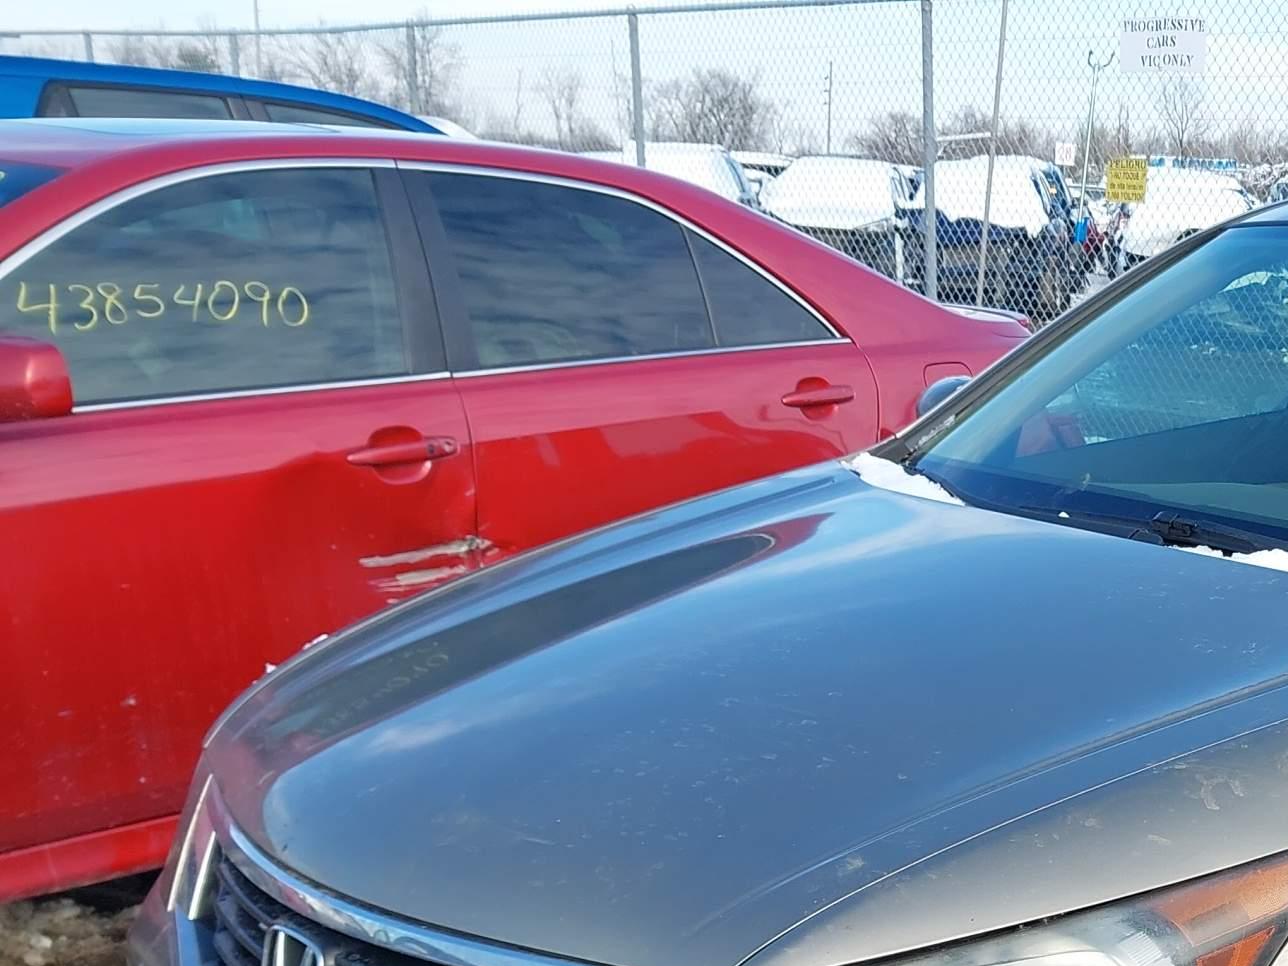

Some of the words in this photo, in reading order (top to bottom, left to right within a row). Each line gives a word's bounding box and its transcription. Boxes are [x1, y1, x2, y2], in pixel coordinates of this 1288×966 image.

[1123, 18, 1206, 33] PROGRESSIVE
[1146, 34, 1176, 49] CARS
[1162, 53, 1194, 67] ONLY
[16, 280, 310, 335] 43854090
